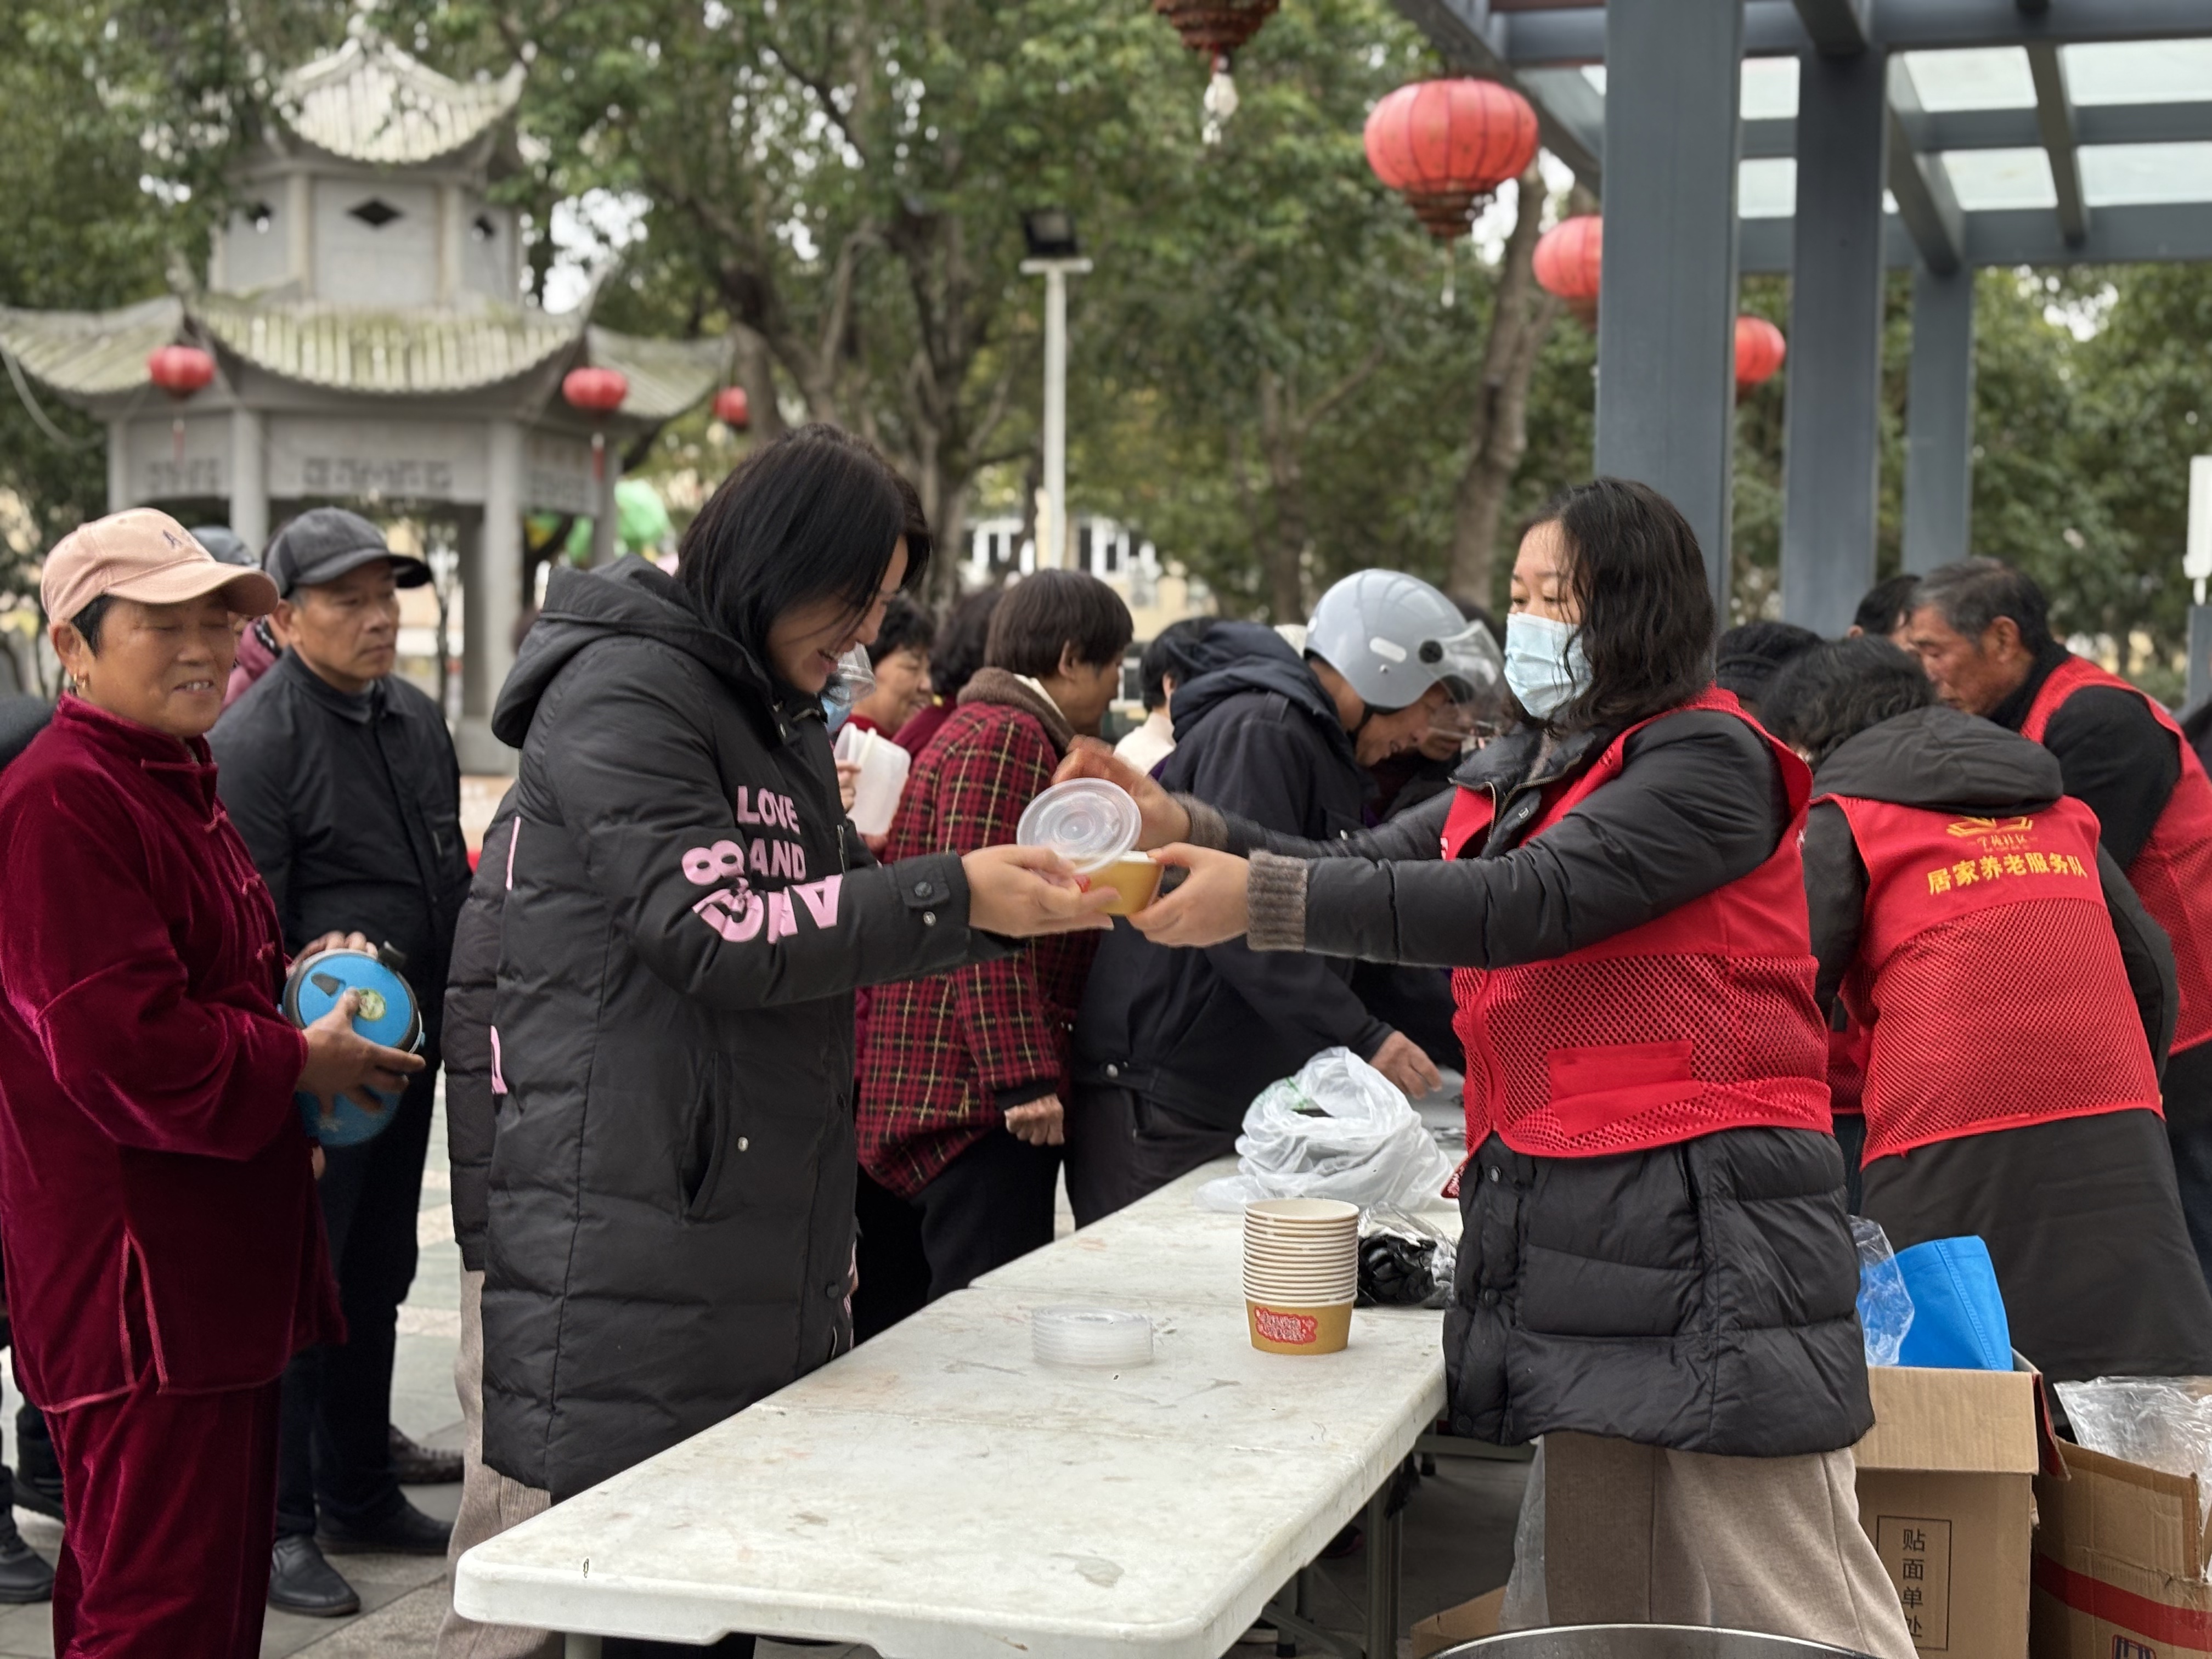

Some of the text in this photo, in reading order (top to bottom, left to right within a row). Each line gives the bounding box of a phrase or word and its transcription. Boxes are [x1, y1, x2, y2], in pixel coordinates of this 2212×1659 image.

[737, 785, 801, 835] LOVE
[749, 837, 806, 882] AND
[1927, 852, 2088, 896] 居家养老服务队
